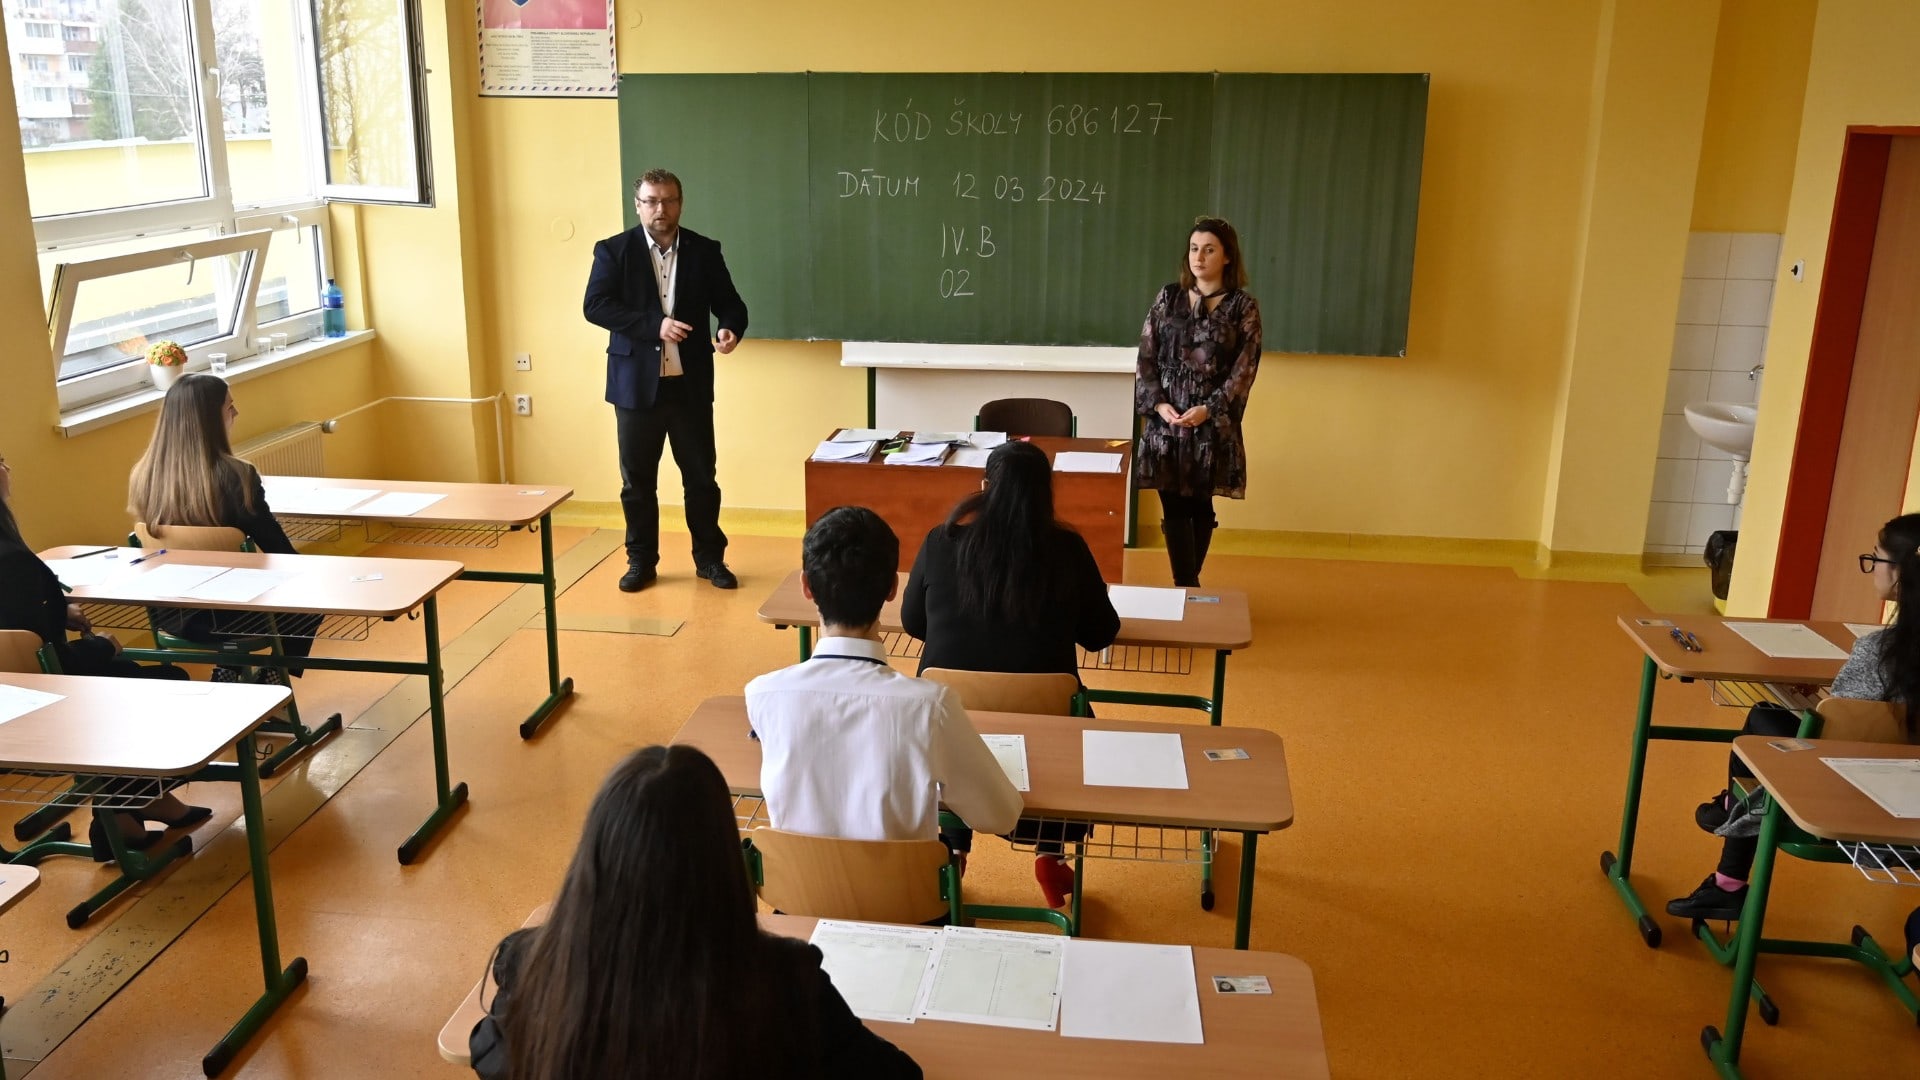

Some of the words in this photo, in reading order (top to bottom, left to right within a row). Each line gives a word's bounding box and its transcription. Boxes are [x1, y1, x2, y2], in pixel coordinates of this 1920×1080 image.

[873, 98, 932, 143] KÓD
[946, 98, 1022, 135] ŠKOLY
[953, 171, 980, 200] 12
[995, 175, 1024, 202] 03
[1037, 176, 1106, 204] 2024
[942, 223, 969, 258] IV.
[977, 225, 996, 257] B
[940, 269, 975, 299] 02
